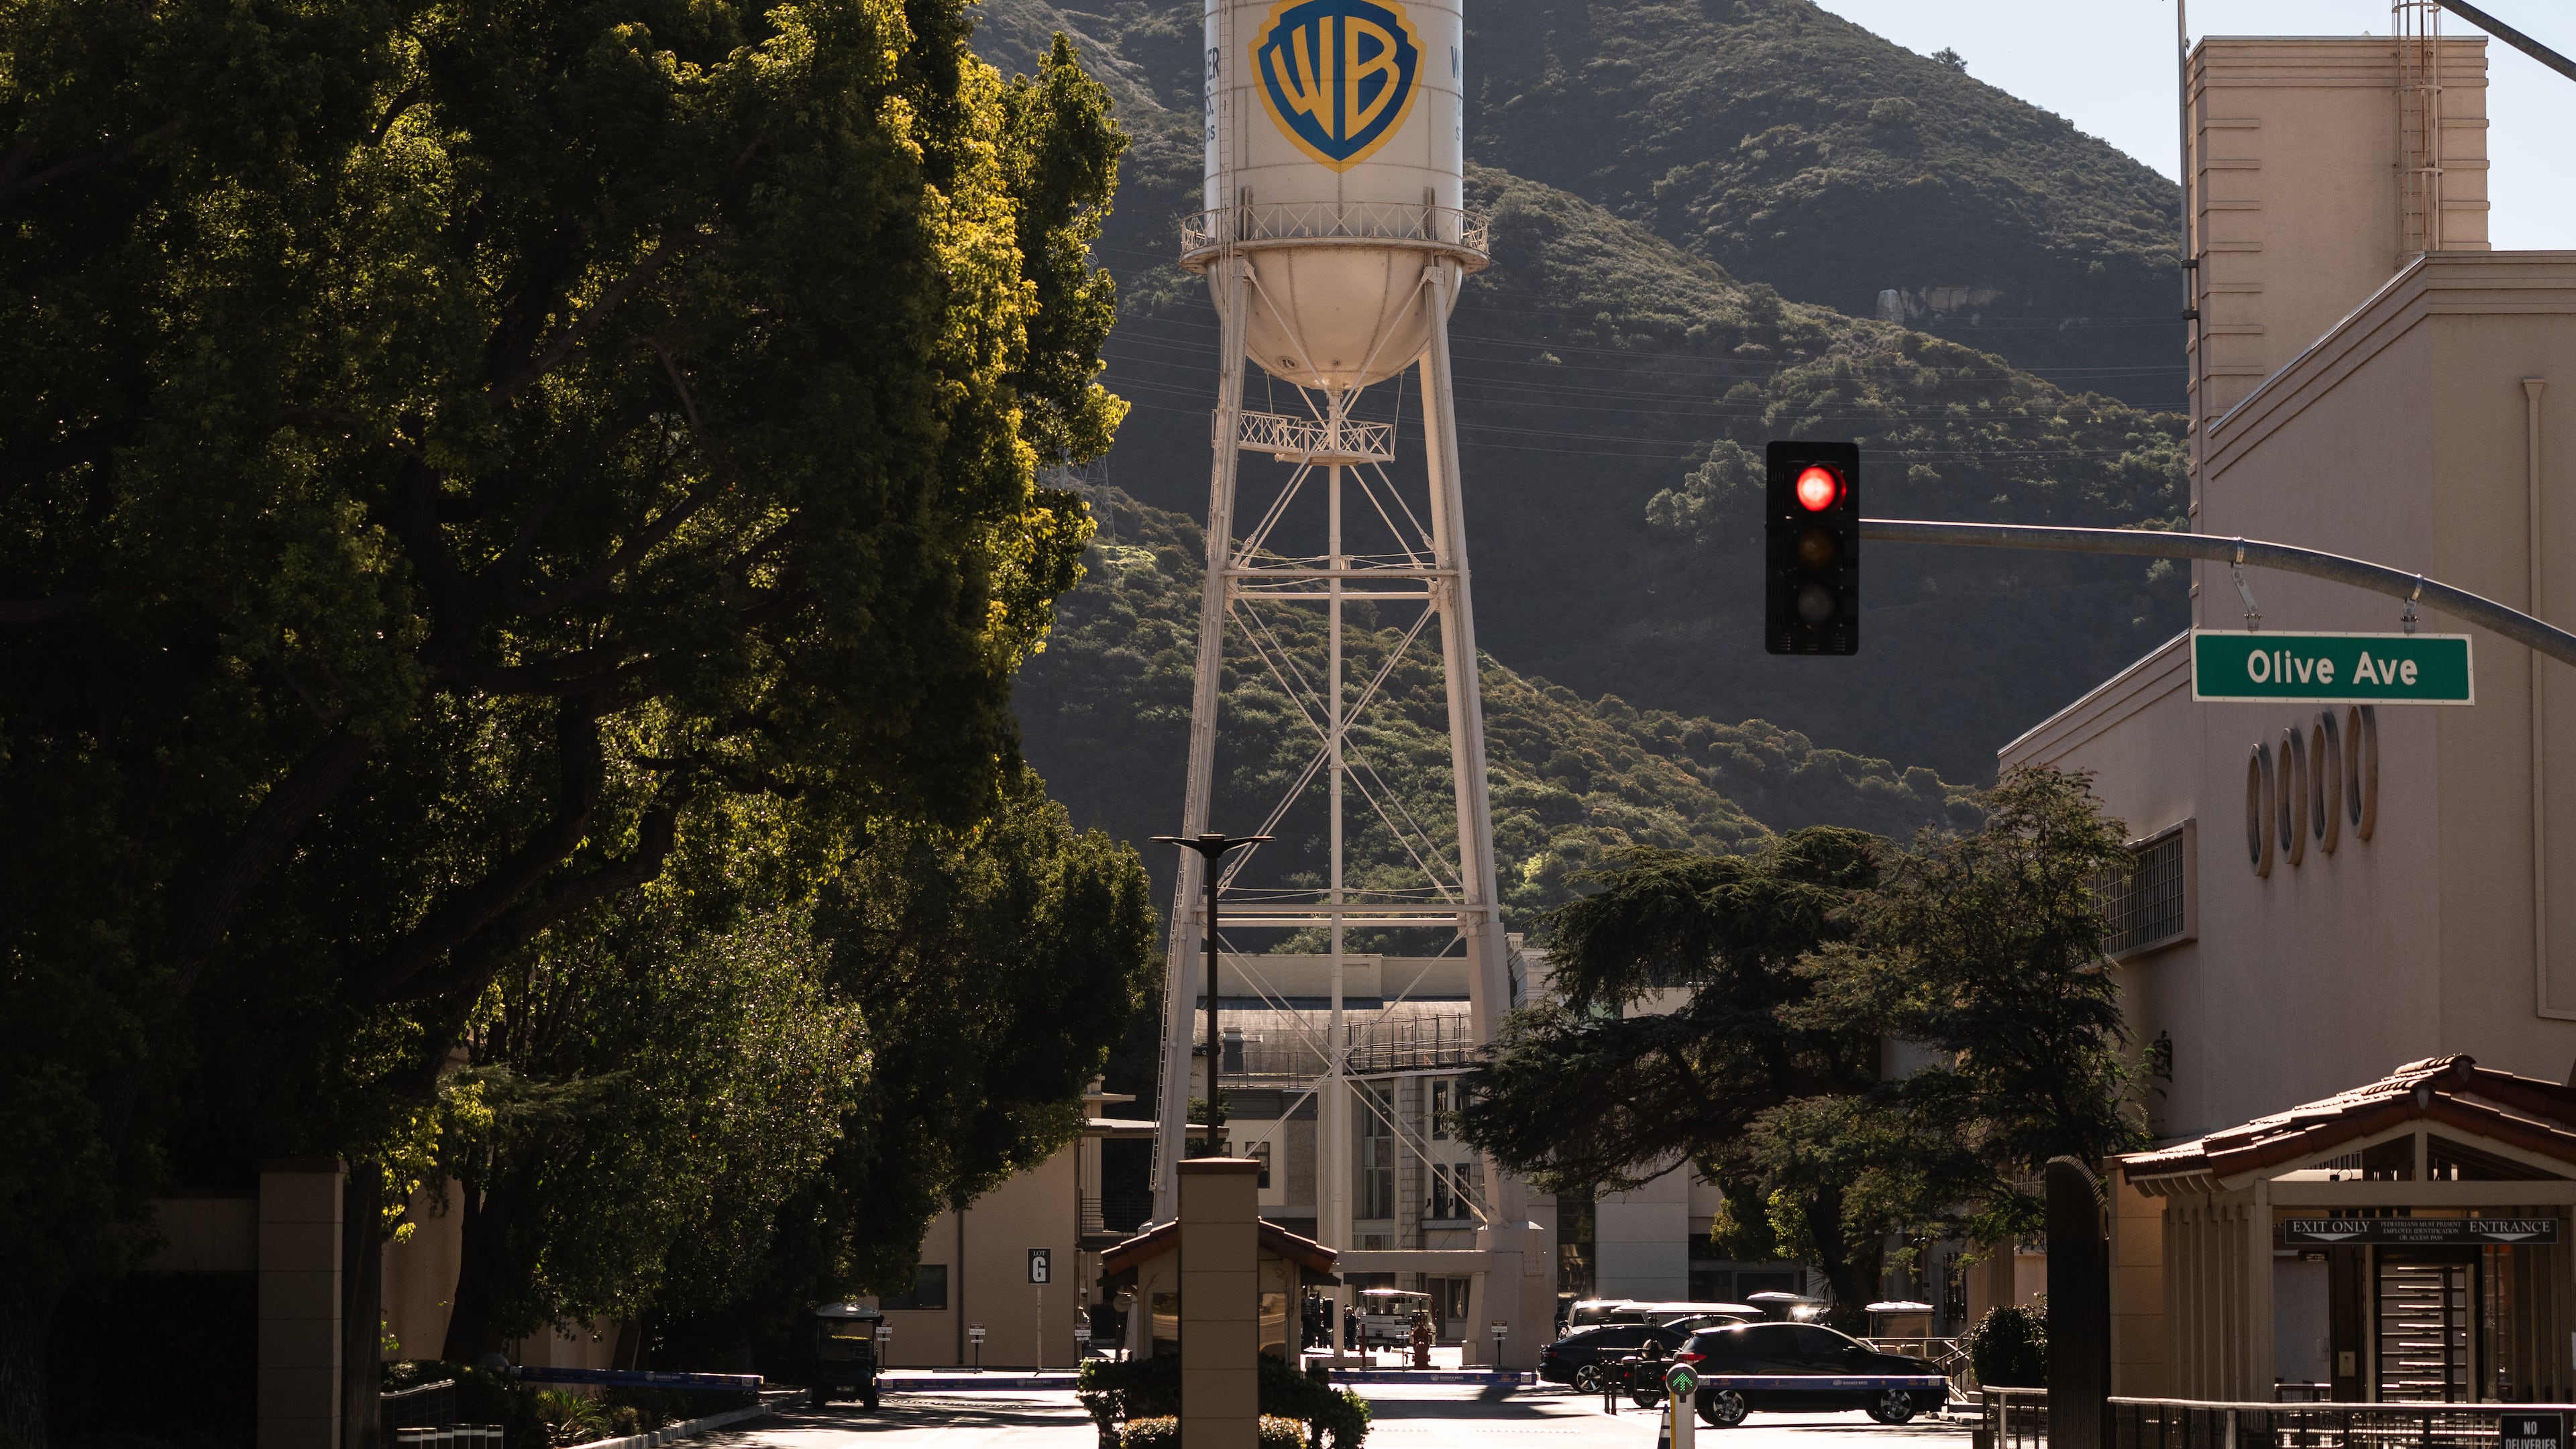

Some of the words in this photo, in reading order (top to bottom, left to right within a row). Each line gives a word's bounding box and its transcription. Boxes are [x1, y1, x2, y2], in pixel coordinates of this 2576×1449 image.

[1270, 15, 1400, 140] WB
[2247, 649, 2334, 684] Olive
[2352, 651, 2418, 686] Ave
[2293, 1221, 2328, 1232] EXIT
[2332, 1221, 2370, 1232] ONLY
[2469, 1221, 2551, 1232] ENTRANCE
[1033, 1256, 1046, 1282] G
[2524, 1421, 2537, 1435] NO
[2506, 1438, 2557, 1449] DELIVERIES
